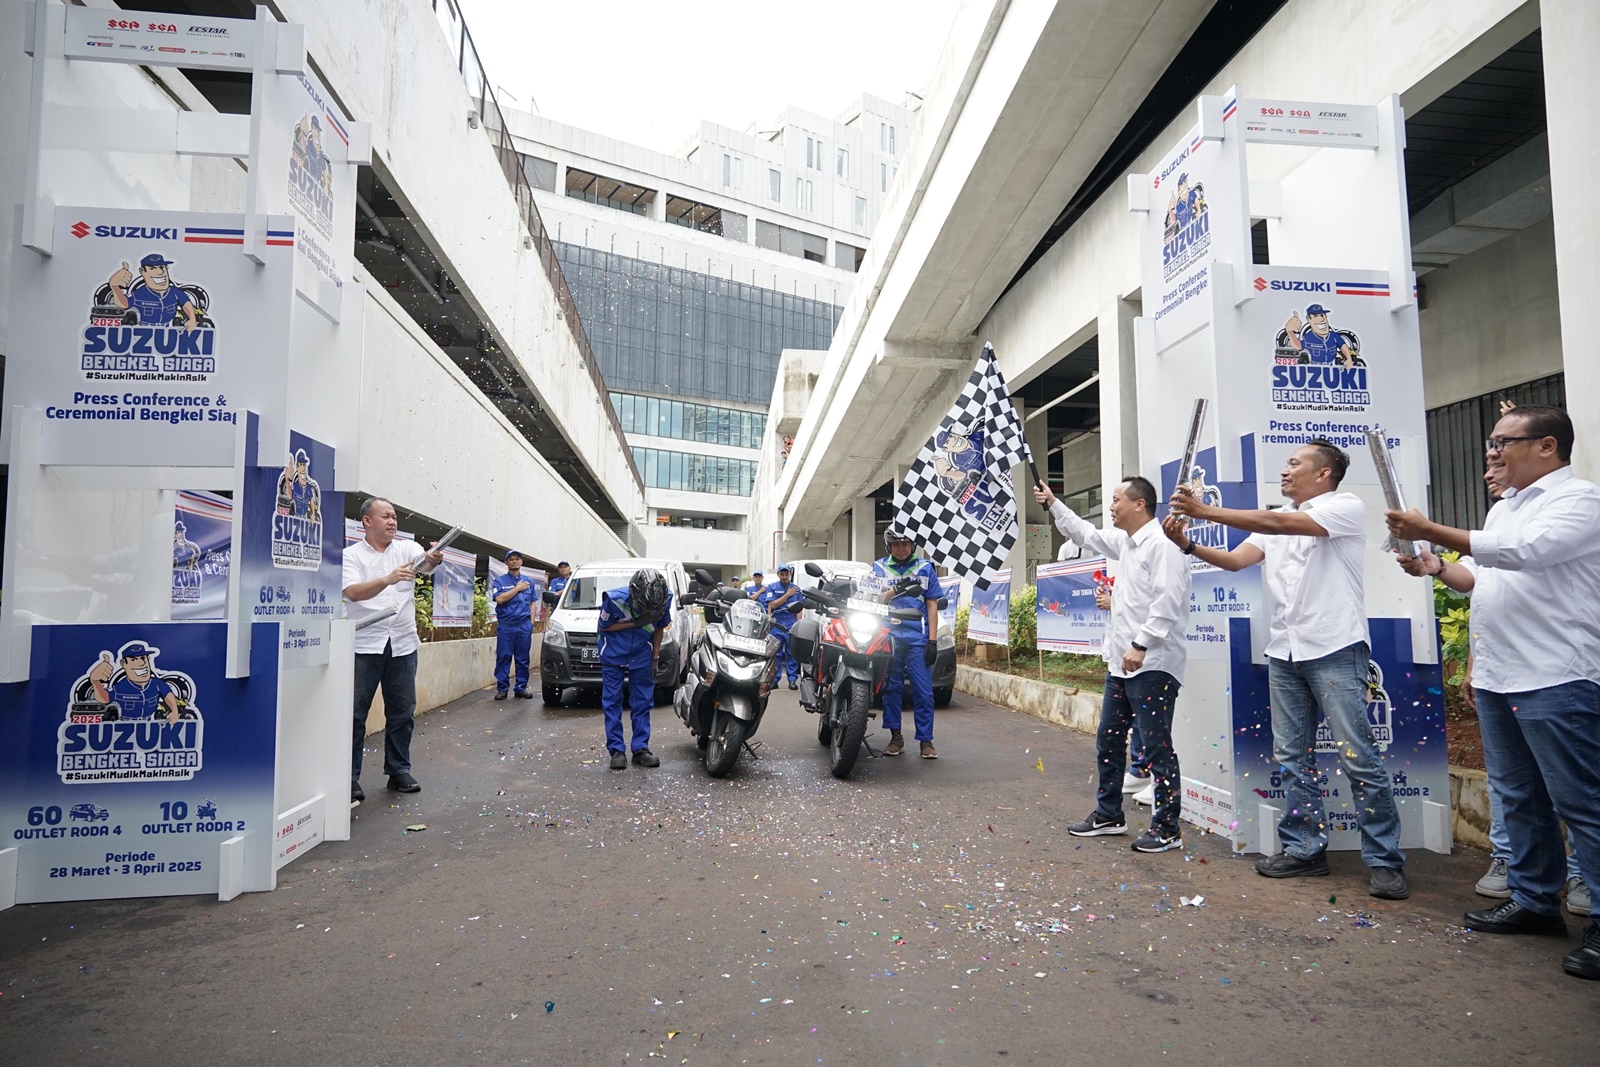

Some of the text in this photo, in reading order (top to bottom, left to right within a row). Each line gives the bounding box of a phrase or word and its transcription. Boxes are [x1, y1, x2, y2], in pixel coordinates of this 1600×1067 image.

[188, 26, 228, 35] ECSTAR
[1161, 147, 1190, 182] SUZUKI
[289, 157, 334, 222] SUZUKI
[95, 225, 178, 240] SUZUKI
[1163, 212, 1209, 266] SUZUKI
[302, 227, 330, 264] Conference
[1271, 280, 1331, 293] SUZUKI
[1162, 288, 1178, 305] Press
[1155, 292, 1184, 321] Ceremonial
[93, 318, 121, 327] 2025
[84, 326, 214, 355] SUZUKI
[82, 354, 215, 373] BENGKEL SIAGA
[1277, 358, 1298, 366] 2025
[86, 371, 207, 382] #SuzukiMudikMakinAsik
[1272, 365, 1367, 390] SUZUKI
[74, 391, 227, 407] Press Conference &
[1272, 389, 1370, 405] BENGKEL SIAGA
[46, 407, 135, 421] Ceremonial
[140, 408, 203, 425] Bengkel
[1270, 420, 1302, 431] Press
[1305, 421, 1369, 434] Conference
[960, 484, 977, 505] 2025
[274, 514, 321, 546] SUZUKI
[273, 540, 303, 559] BENGKEL
[859, 581, 880, 589] SUZUKI
[259, 585, 274, 604] 60
[307, 588, 317, 604] 10
[1213, 586, 1225, 602] 10
[254, 605, 295, 616] OUTLET RODA 4
[301, 605, 334, 615] OUTLET RODA 2
[739, 609, 760, 617] SUZUKI
[1208, 602, 1250, 612] OUTLET RODA 2
[288, 629, 306, 638] Periode
[1196, 624, 1215, 633] Periode
[294, 639, 298, 648] 3
[298, 638, 309, 649] April
[309, 637, 321, 647] 2025
[1207, 634, 1219, 643] April
[73, 715, 102, 724] 2025
[64, 722, 197, 753] SUZUKI
[61, 751, 198, 771] BENGKEL SIAGA
[65, 769, 190, 781] #SuzukiMudikMakinAsik
[1332, 788, 1339, 797] 4
[1393, 787, 1429, 797] RODA 2
[27, 805, 62, 826] 60
[160, 801, 188, 822] 10
[13, 825, 122, 840] OUTLET RODA 4
[141, 820, 246, 835] OUTLET RODA 2
[1342, 822, 1348, 831] 3
[105, 851, 156, 863] Periode
[50, 867, 67, 878] 28
[71, 864, 111, 877] Maret
[121, 864, 131, 875] 3
[133, 862, 165, 876] April
[169, 861, 202, 872] 2025
